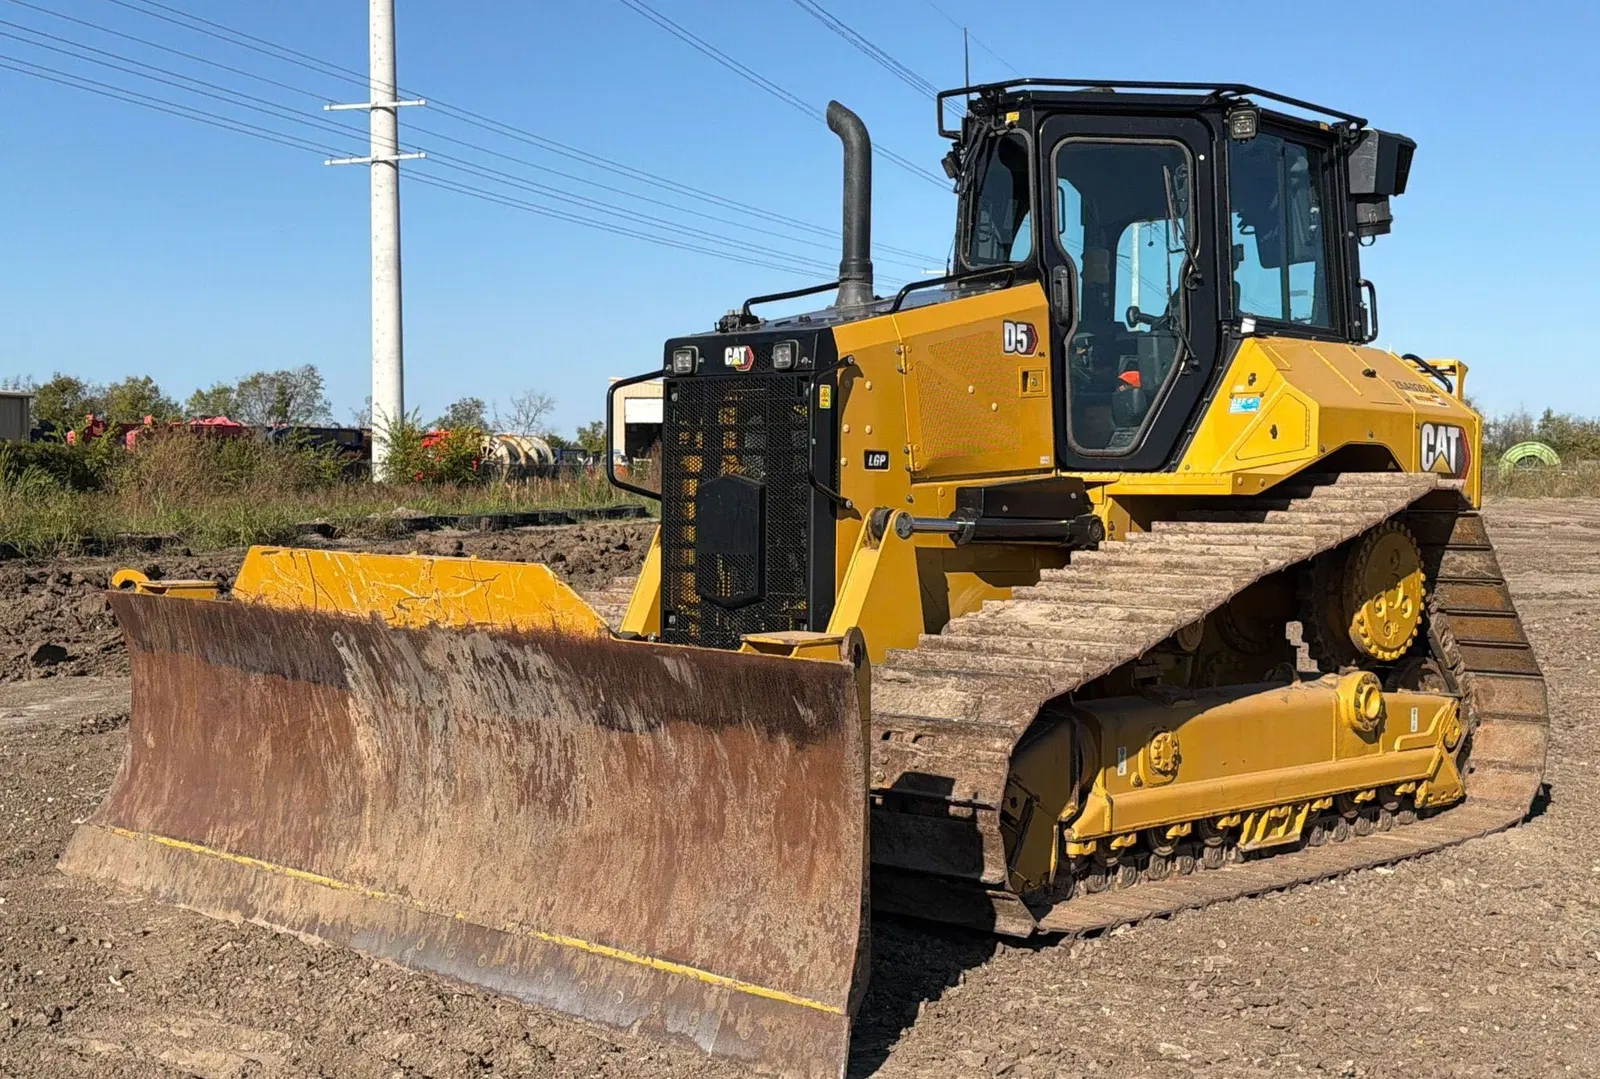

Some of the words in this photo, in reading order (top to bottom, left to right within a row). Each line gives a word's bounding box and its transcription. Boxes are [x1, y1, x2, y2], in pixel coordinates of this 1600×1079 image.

[1003, 321, 1028, 353] D5
[724, 346, 747, 366] CAT
[868, 454, 887, 467] LGP
[1421, 423, 1460, 474] CAT
